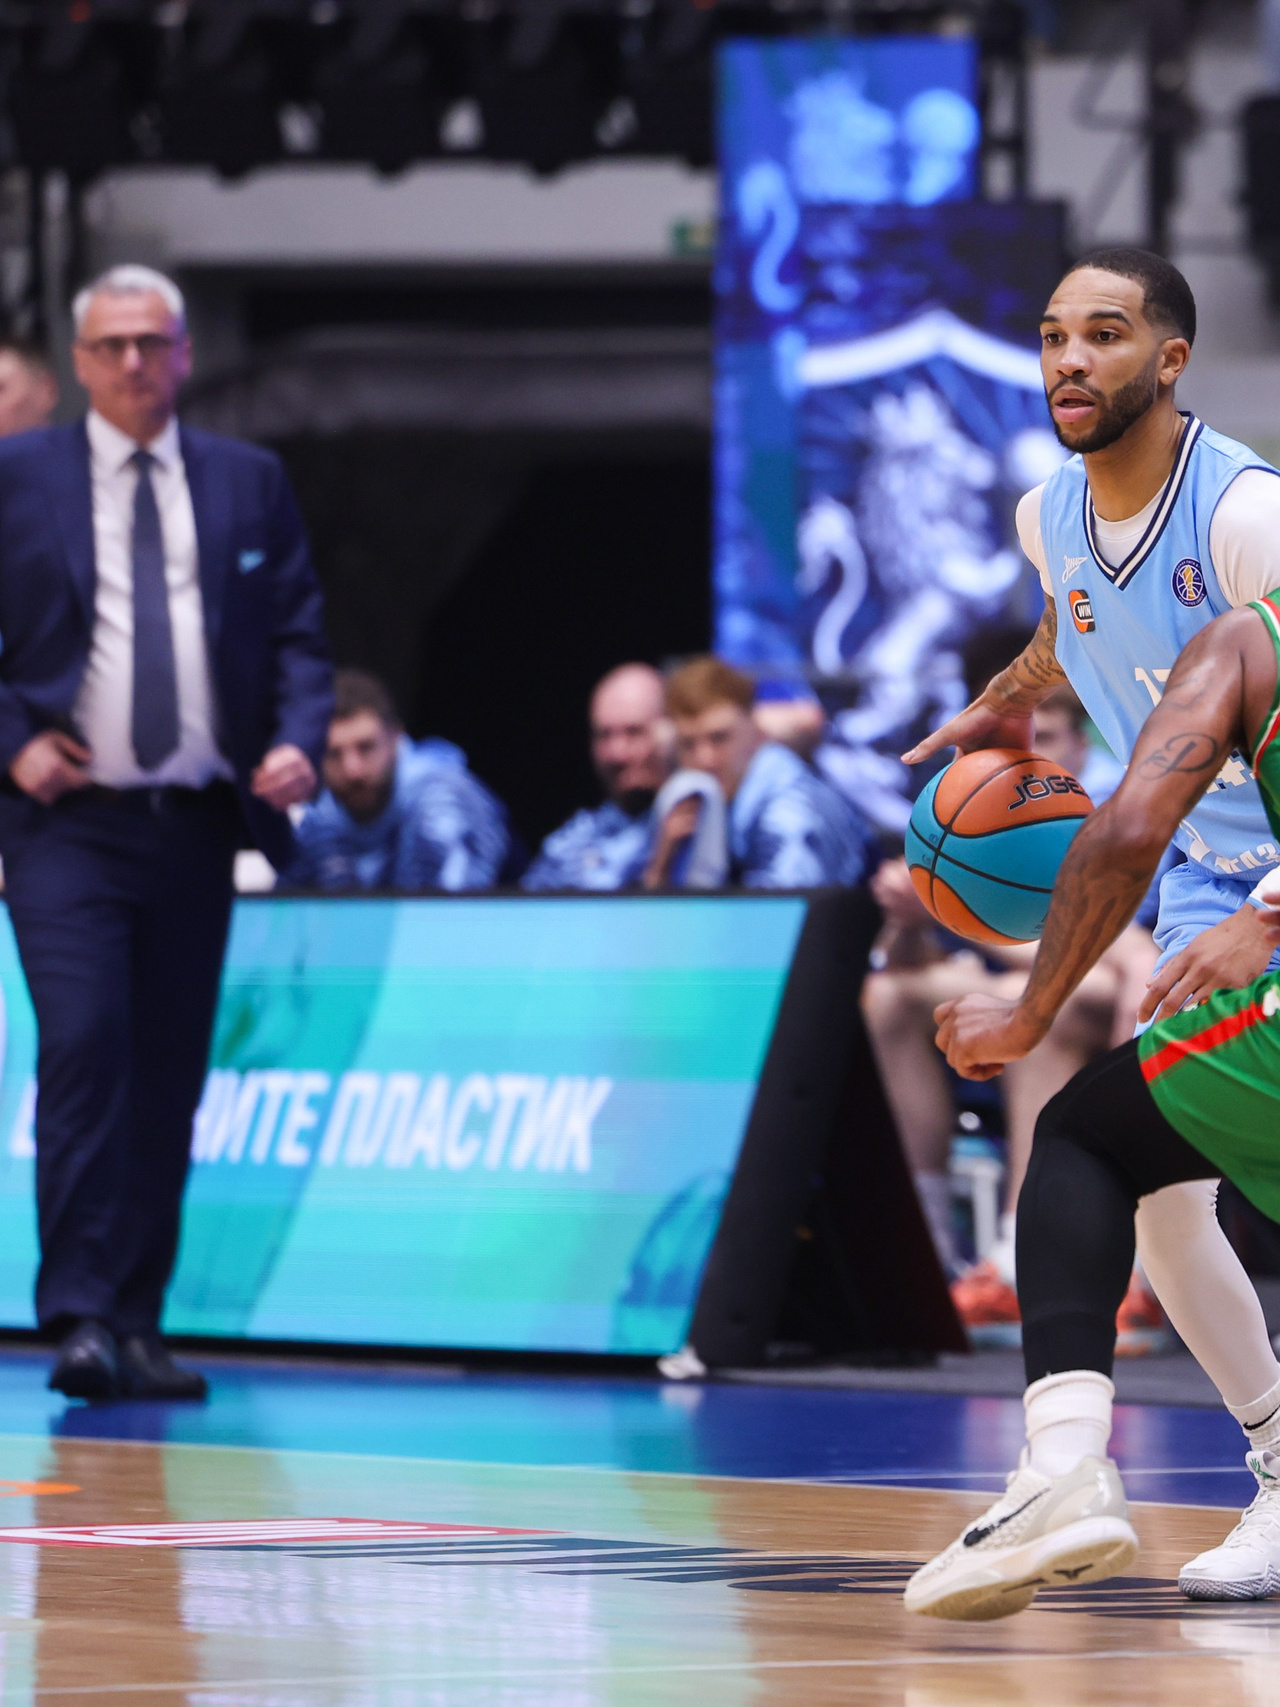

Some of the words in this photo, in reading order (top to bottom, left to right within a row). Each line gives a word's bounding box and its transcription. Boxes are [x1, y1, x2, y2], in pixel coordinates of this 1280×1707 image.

[1077, 604, 1092, 618] WIN
[1008, 774, 1090, 810] JÖGE
[319, 1071, 613, 1172] ПЛАСТИК
